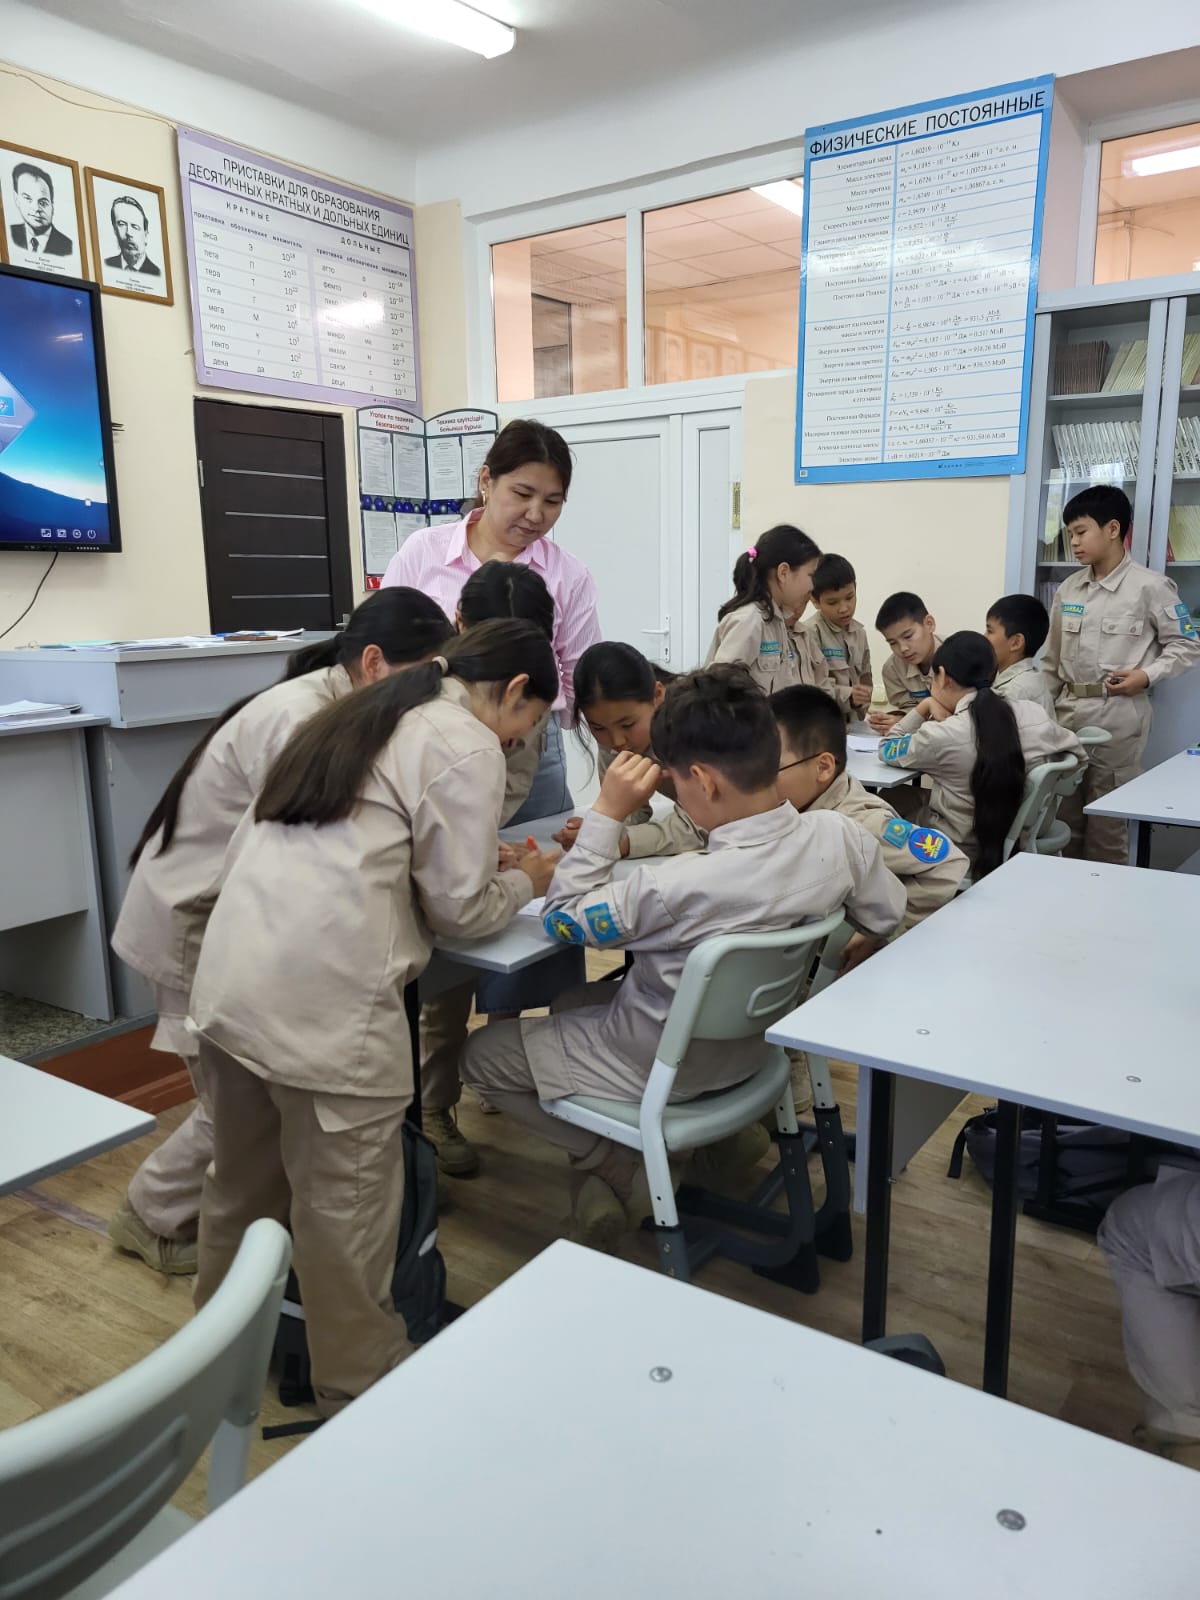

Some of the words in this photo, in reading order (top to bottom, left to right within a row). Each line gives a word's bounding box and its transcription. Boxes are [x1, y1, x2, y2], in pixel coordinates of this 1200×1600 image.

[809, 119, 917, 156] ФИЗИЧЕСКИЕ
[925, 90, 1046, 132] ПОСТОЯННЫЕ
[188, 162, 263, 199] ДЕСЯТИЧНЫХ
[265, 190, 311, 215] КРАТНЫХ
[313, 205, 321, 218] И
[323, 209, 370, 233] ДОЛЬНЫХ
[371, 223, 410, 247] ЕДИНИЦ
[223, 158, 286, 191] ПРИСТАВКИ
[288, 181, 309, 199] ДЛЯ
[311, 190, 381, 222] ОБРАЗОВАНИЯ
